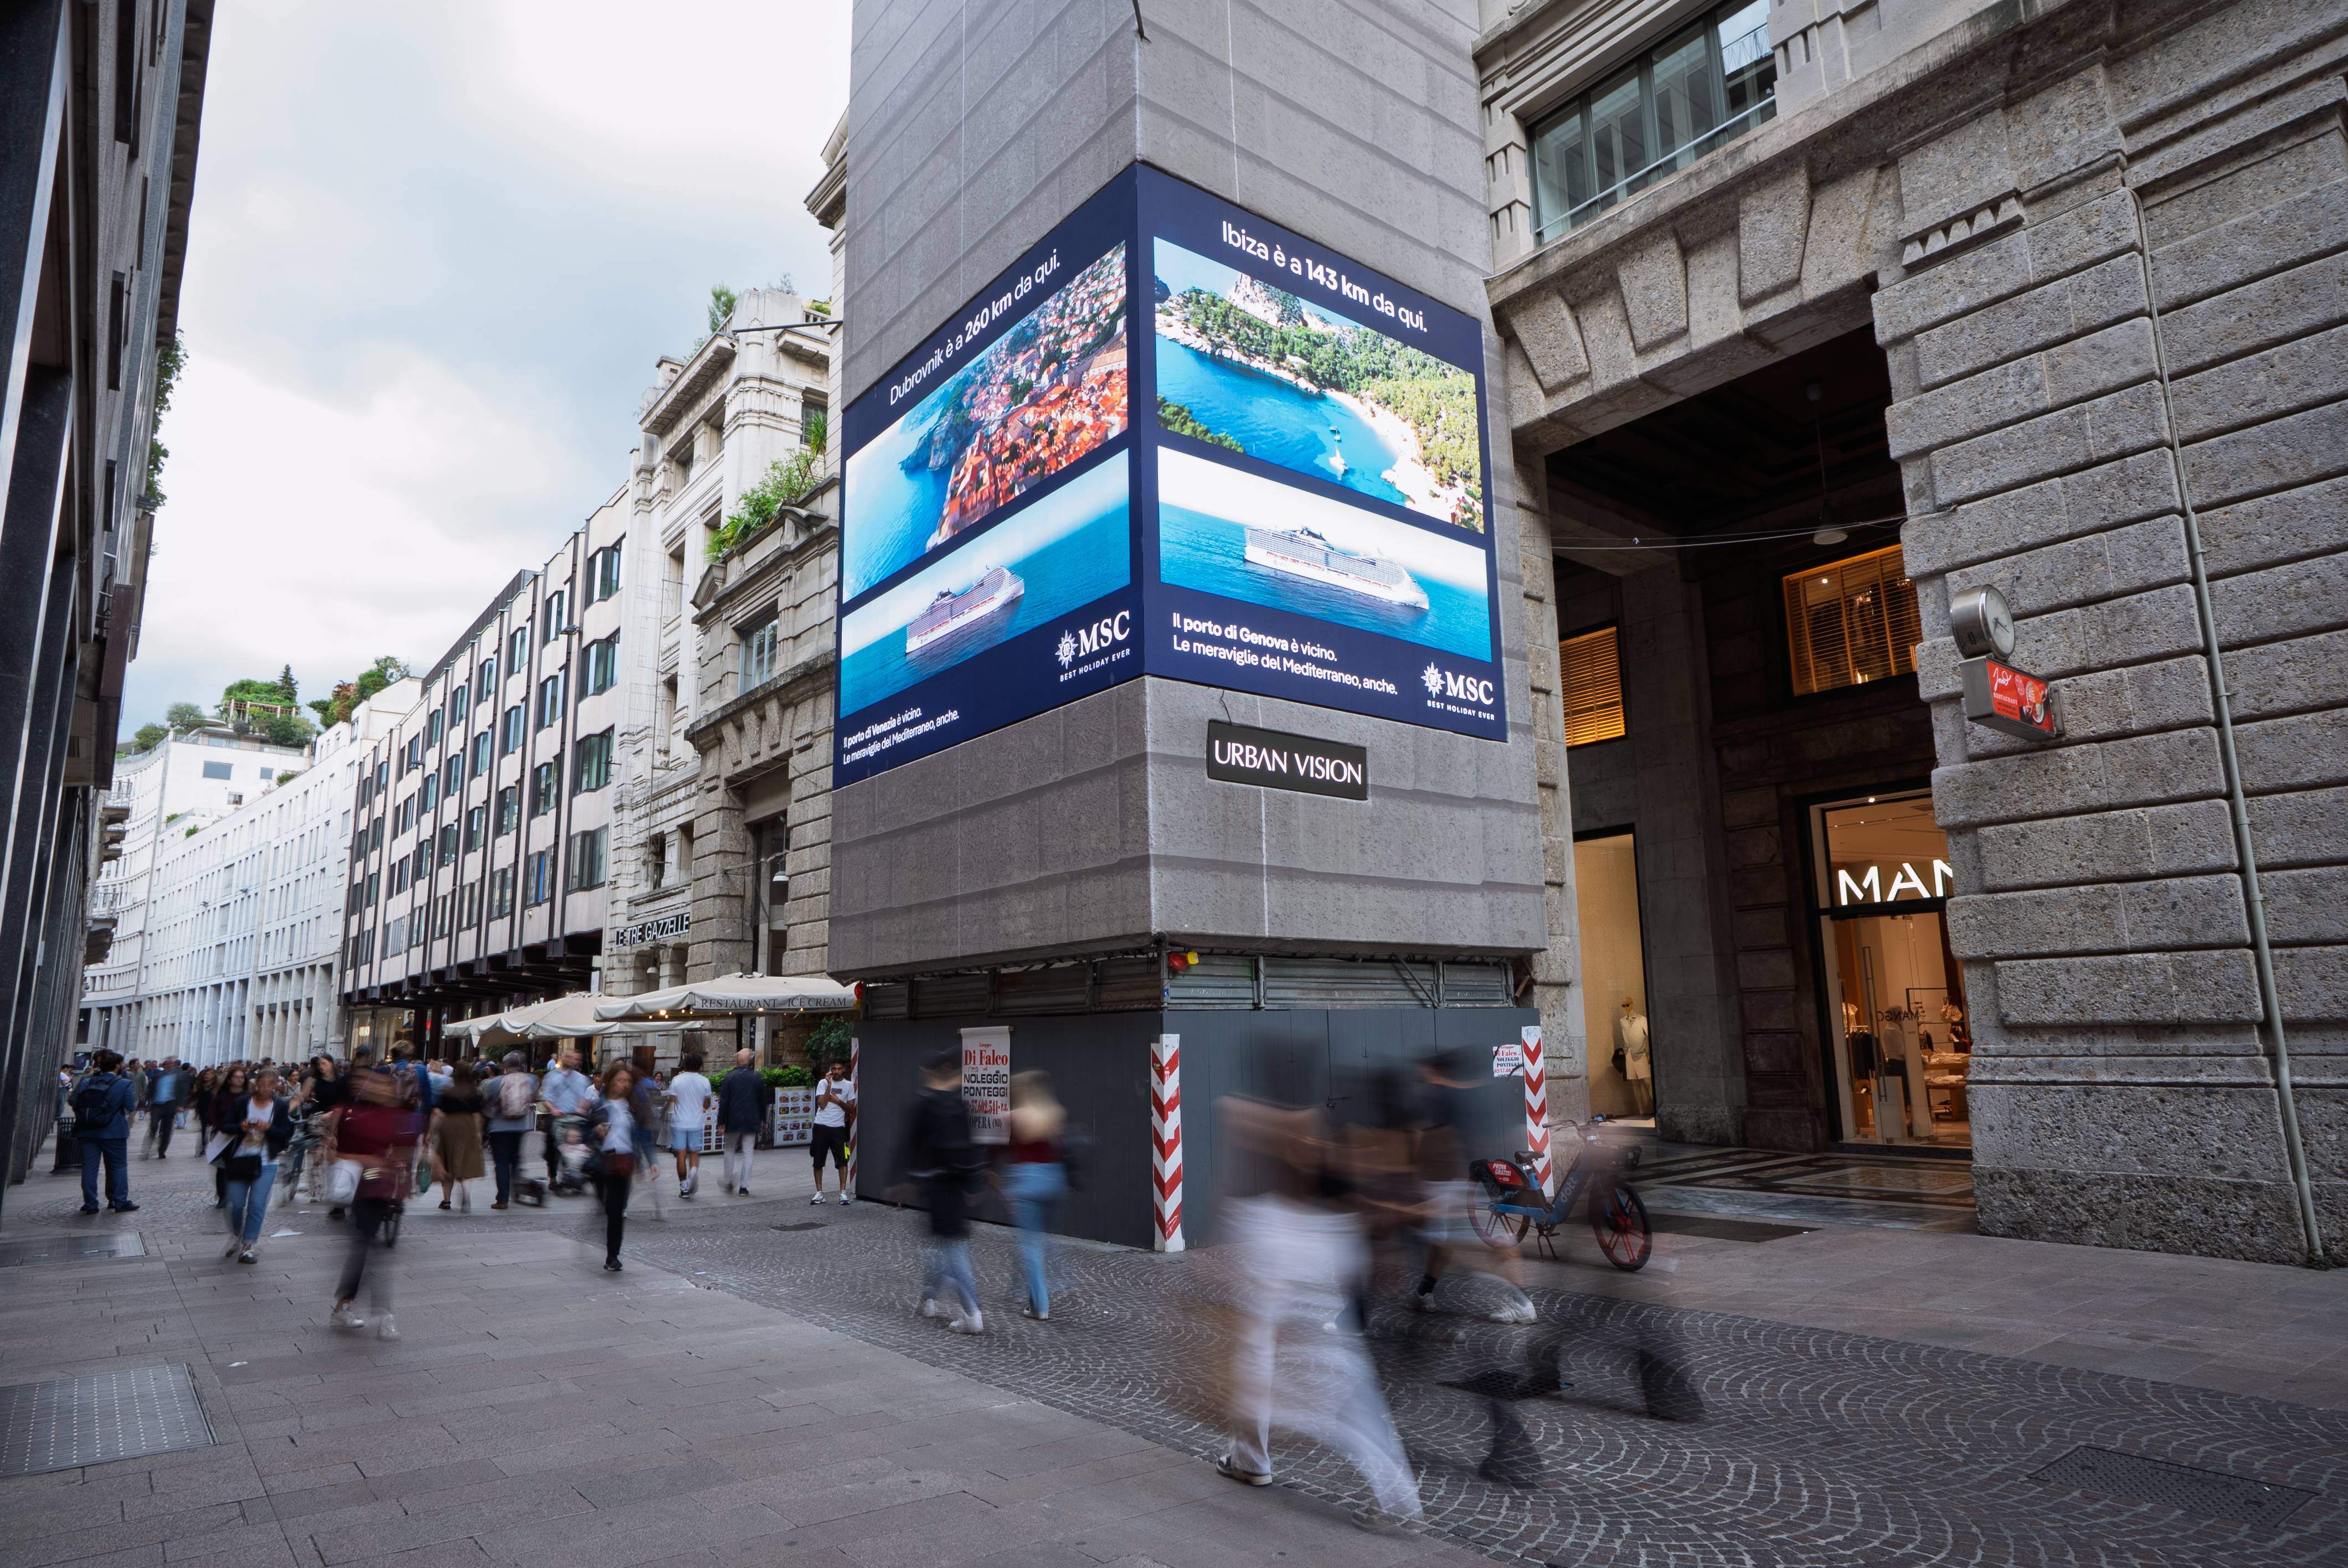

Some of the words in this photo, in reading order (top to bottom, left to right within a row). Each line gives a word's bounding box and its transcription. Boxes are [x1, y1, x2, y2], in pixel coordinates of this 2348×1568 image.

[1222, 220, 1269, 261] Ibiza
[1273, 244, 1286, 267] è
[1290, 257, 1302, 276] a
[1305, 258, 1338, 291] 143
[1341, 275, 1369, 306] km
[1372, 293, 1395, 318] da
[1398, 307, 1428, 333] qui.
[890, 348, 944, 406] Dubrovnik
[945, 339, 954, 358] è
[955, 334, 963, 350] a
[965, 307, 990, 343] 260
[992, 292, 1012, 321] km
[1014, 276, 1032, 300] da
[1034, 249, 1060, 285] qui.
[1078, 610, 1130, 657] MSC
[1173, 612, 1182, 628] Il
[1183, 618, 1222, 637] porto
[1224, 625, 1238, 640] di
[1239, 627, 1289, 651] Genova
[1290, 638, 1299, 653] è
[1300, 641, 1337, 662] vicino.
[1060, 670, 1077, 682] BEST
[1079, 657, 1109, 675] HOLIDAY
[1112, 648, 1130, 662] EVER
[1173, 635, 1191, 652] Le
[1193, 642, 1259, 666] meraviglie
[1260, 653, 1281, 670] del
[1283, 657, 1362, 689] Mediterraneo,
[1362, 678, 1398, 695] anche.
[1445, 671, 1494, 705] MSC
[1993, 692, 2018, 705] RESTAURANT
[1427, 700, 1445, 709] BEST
[1446, 704, 1476, 716] HOLIDAY
[1478, 711, 1495, 721] EVER
[843, 736, 848, 748] Il
[847, 731, 865, 749] porto
[864, 726, 872, 739] di
[871, 718, 897, 736] Venezia
[897, 715, 902, 726] è
[902, 708, 923, 723] vicino.
[843, 754, 851, 765] Le
[851, 740, 881, 762] meraviglie
[881, 735, 892, 750] del
[892, 720, 936, 745] Mediterraneo,
[936, 710, 960, 727] anche.
[1215, 740, 1286, 773] URBAN
[1295, 754, 1361, 785] VISION
[615, 930, 624, 947] LE
[627, 925, 642, 945] TRE
[645, 914, 690, 941] GAZZELLE
[702, 998, 778, 1008] RESTAURANT
[787, 998, 805, 1007] ICE
[807, 997, 846, 1007] CREAM
[964, 1050, 976, 1066] Di
[979, 1049, 1008, 1066] Falco
[964, 1074, 1008, 1084] NOLEGGIO
[964, 1086, 1008, 1097] PONTEGGI
[970, 1115, 991, 1129] OPERA
[1561, 1177, 1578, 1203] dott
